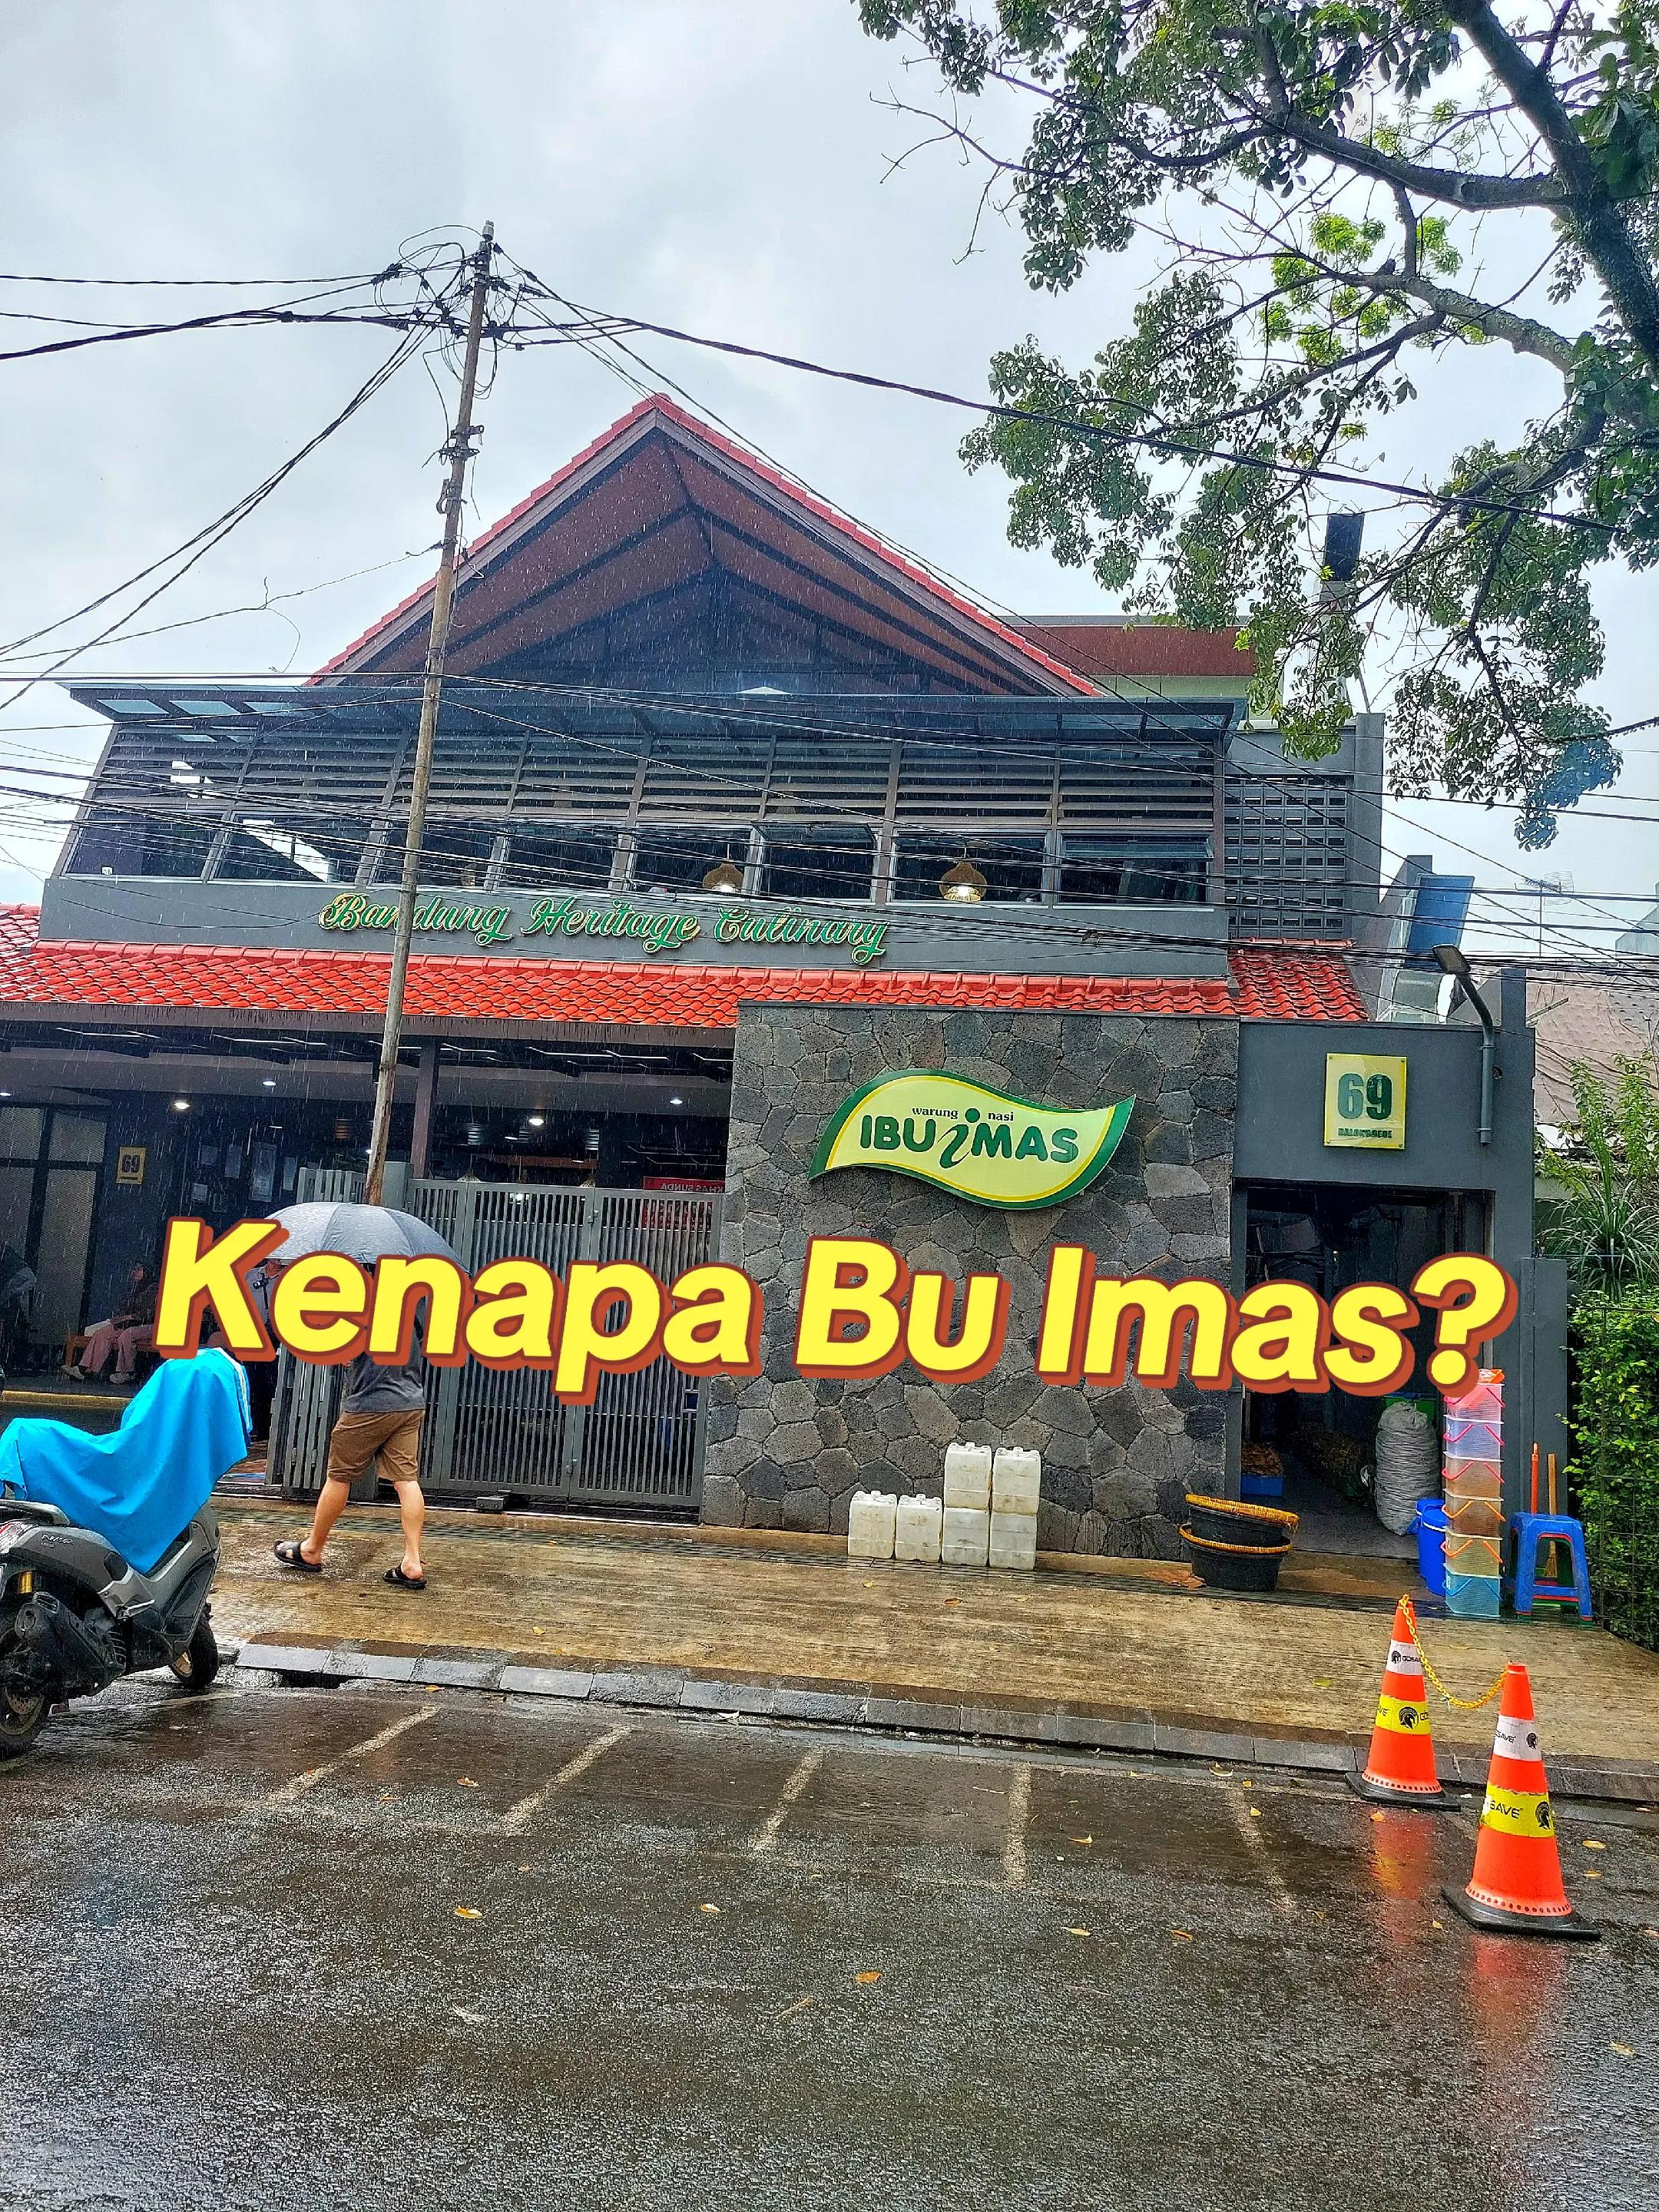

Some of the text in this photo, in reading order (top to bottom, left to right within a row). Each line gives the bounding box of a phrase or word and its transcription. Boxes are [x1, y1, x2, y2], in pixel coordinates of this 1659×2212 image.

[520, 896, 700, 954] Heritage
[714, 907, 889, 965] Culinary
[1337, 1073, 1392, 1121] 69
[912, 1108, 1014, 1121] warung nasi
[860, 1114, 936, 1152] IBU
[122, 1154, 140, 1173] 69
[1485, 1800, 1520, 1819] SAVE
